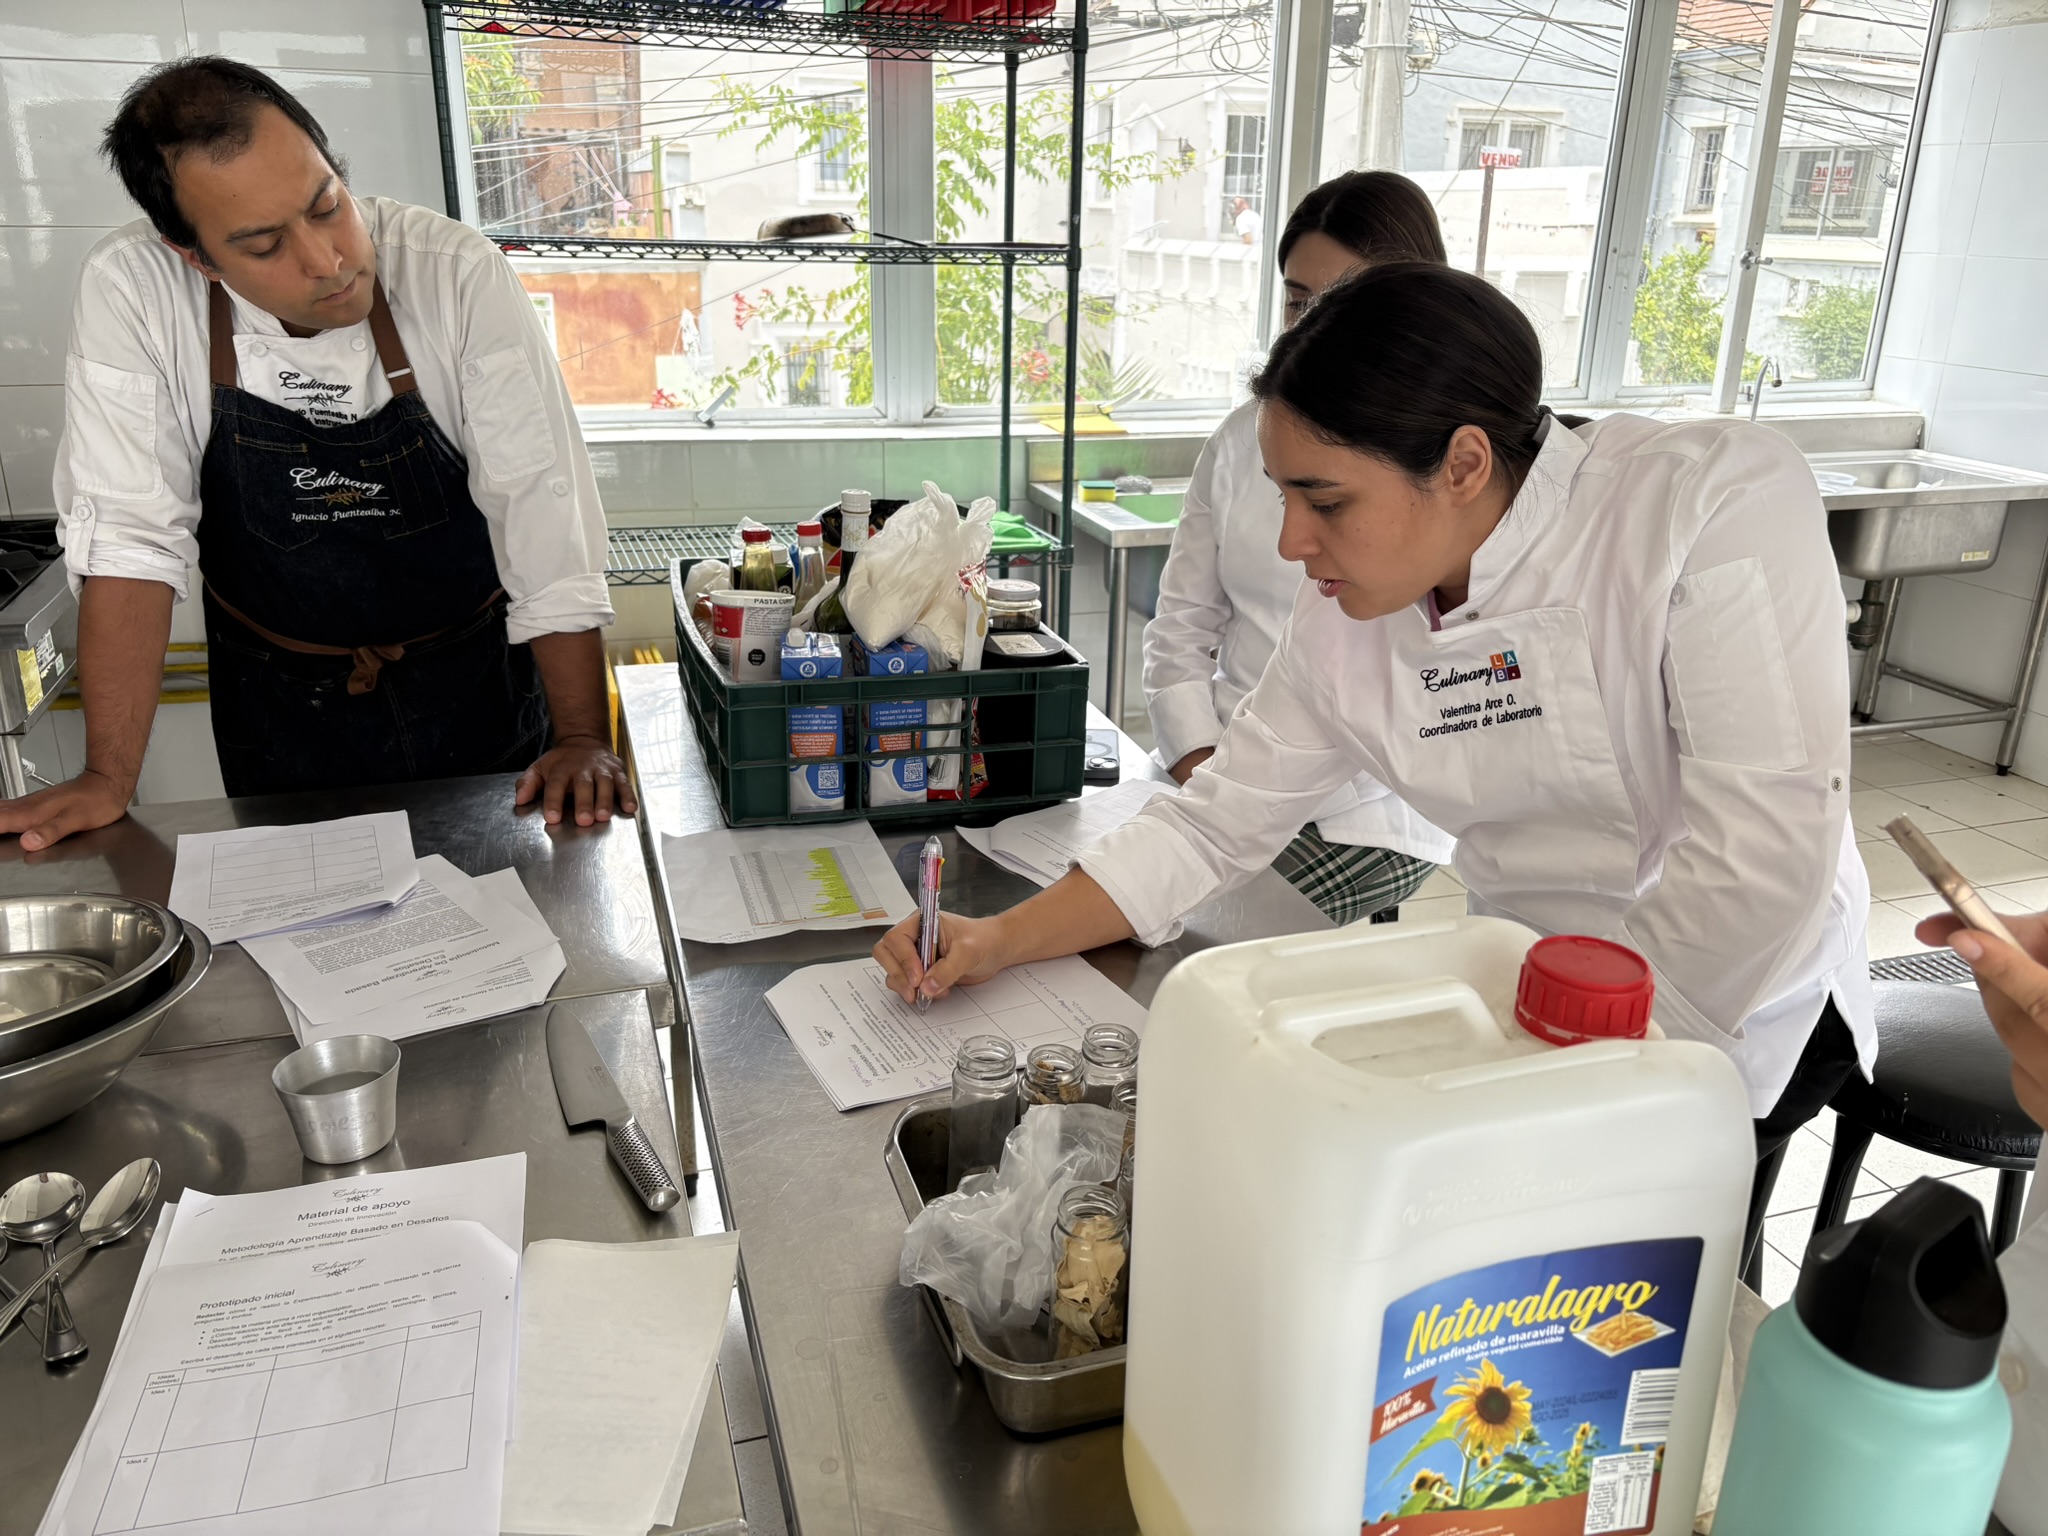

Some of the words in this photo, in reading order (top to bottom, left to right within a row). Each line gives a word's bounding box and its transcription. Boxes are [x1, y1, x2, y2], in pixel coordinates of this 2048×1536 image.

[1482, 152, 1521, 167] VENDE
[279, 371, 352, 398] Culinary
[290, 467, 385, 496] Culinary
[291, 512, 329, 522] Ignacio
[332, 508, 386, 521] Fuentealba
[389, 508, 401, 516] N.
[1420, 667, 1493, 692] Culinary
[1440, 702, 1481, 719] Valentina
[1485, 698, 1503, 711] Arce
[1419, 718, 1478, 738] Coordinadora
[1482, 714, 1493, 727] de
[1496, 705, 1542, 724] Laboratorio
[381, 964, 432, 982] Aprendizaje
[332, 1187, 384, 1199] Culinary
[297, 1206, 349, 1222] Material
[352, 1204, 368, 1213] de
[371, 1199, 411, 1212] apoyo
[307, 1217, 344, 1228] Dirección
[356, 1210, 397, 1221] Innovación
[221, 1239, 285, 1255] Metodología
[287, 1230, 348, 1246] Aprendizaje
[350, 1223, 388, 1235] Basado
[391, 1221, 404, 1229] en
[406, 1214, 450, 1226] Desafíos
[311, 1257, 367, 1273] Culinary
[199, 1296, 261, 1310] Prototipado
[264, 1289, 295, 1301] inicial
[196, 1311, 225, 1320] Redactar
[1405, 1275, 1660, 1363] Naturalagro
[321, 1340, 365, 1354] Procedimiento
[1403, 1357, 1438, 1380] Aceite
[1439, 1339, 1488, 1364] refinado
[1490, 1334, 1506, 1347] de
[1508, 1324, 1565, 1344] maravilla
[1465, 1350, 1490, 1363] Aceite
[1491, 1343, 1519, 1357] vegetal
[1520, 1335, 1564, 1350] comestible
[1383, 1390, 1412, 1418] 100%
[1380, 1399, 1428, 1435] Maravilla
